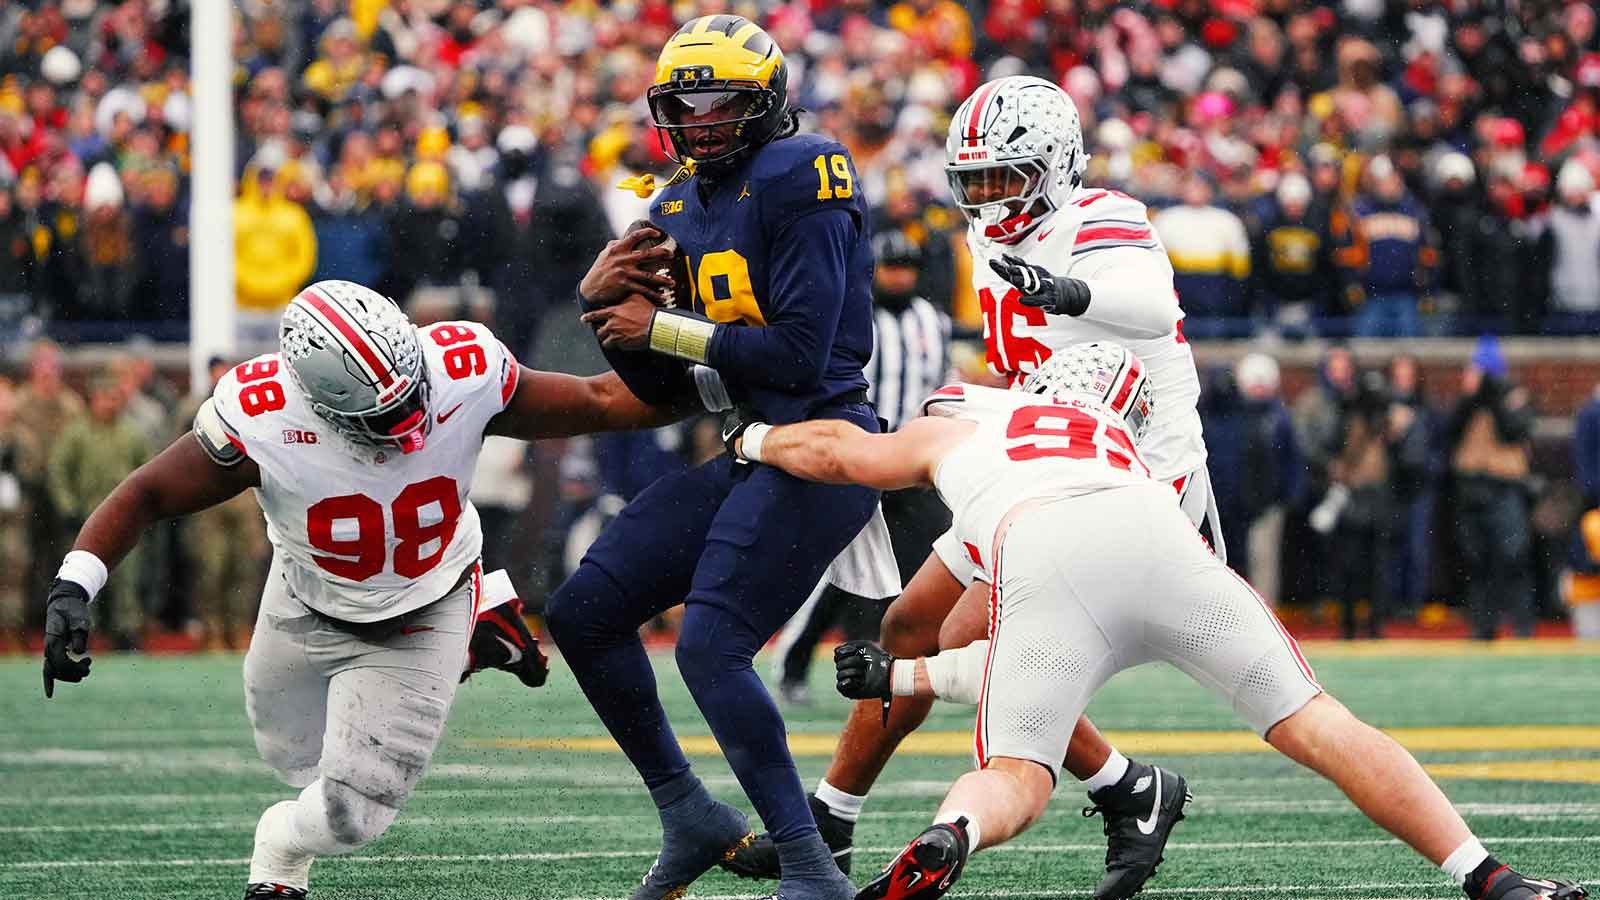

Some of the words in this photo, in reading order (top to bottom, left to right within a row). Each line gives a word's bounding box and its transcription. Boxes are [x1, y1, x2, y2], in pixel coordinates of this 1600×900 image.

[814, 154, 853, 200] 19
[685, 248, 768, 328] 9
[430, 325, 488, 380] 98
[235, 359, 286, 418] 98
[306, 475, 463, 582] 98
